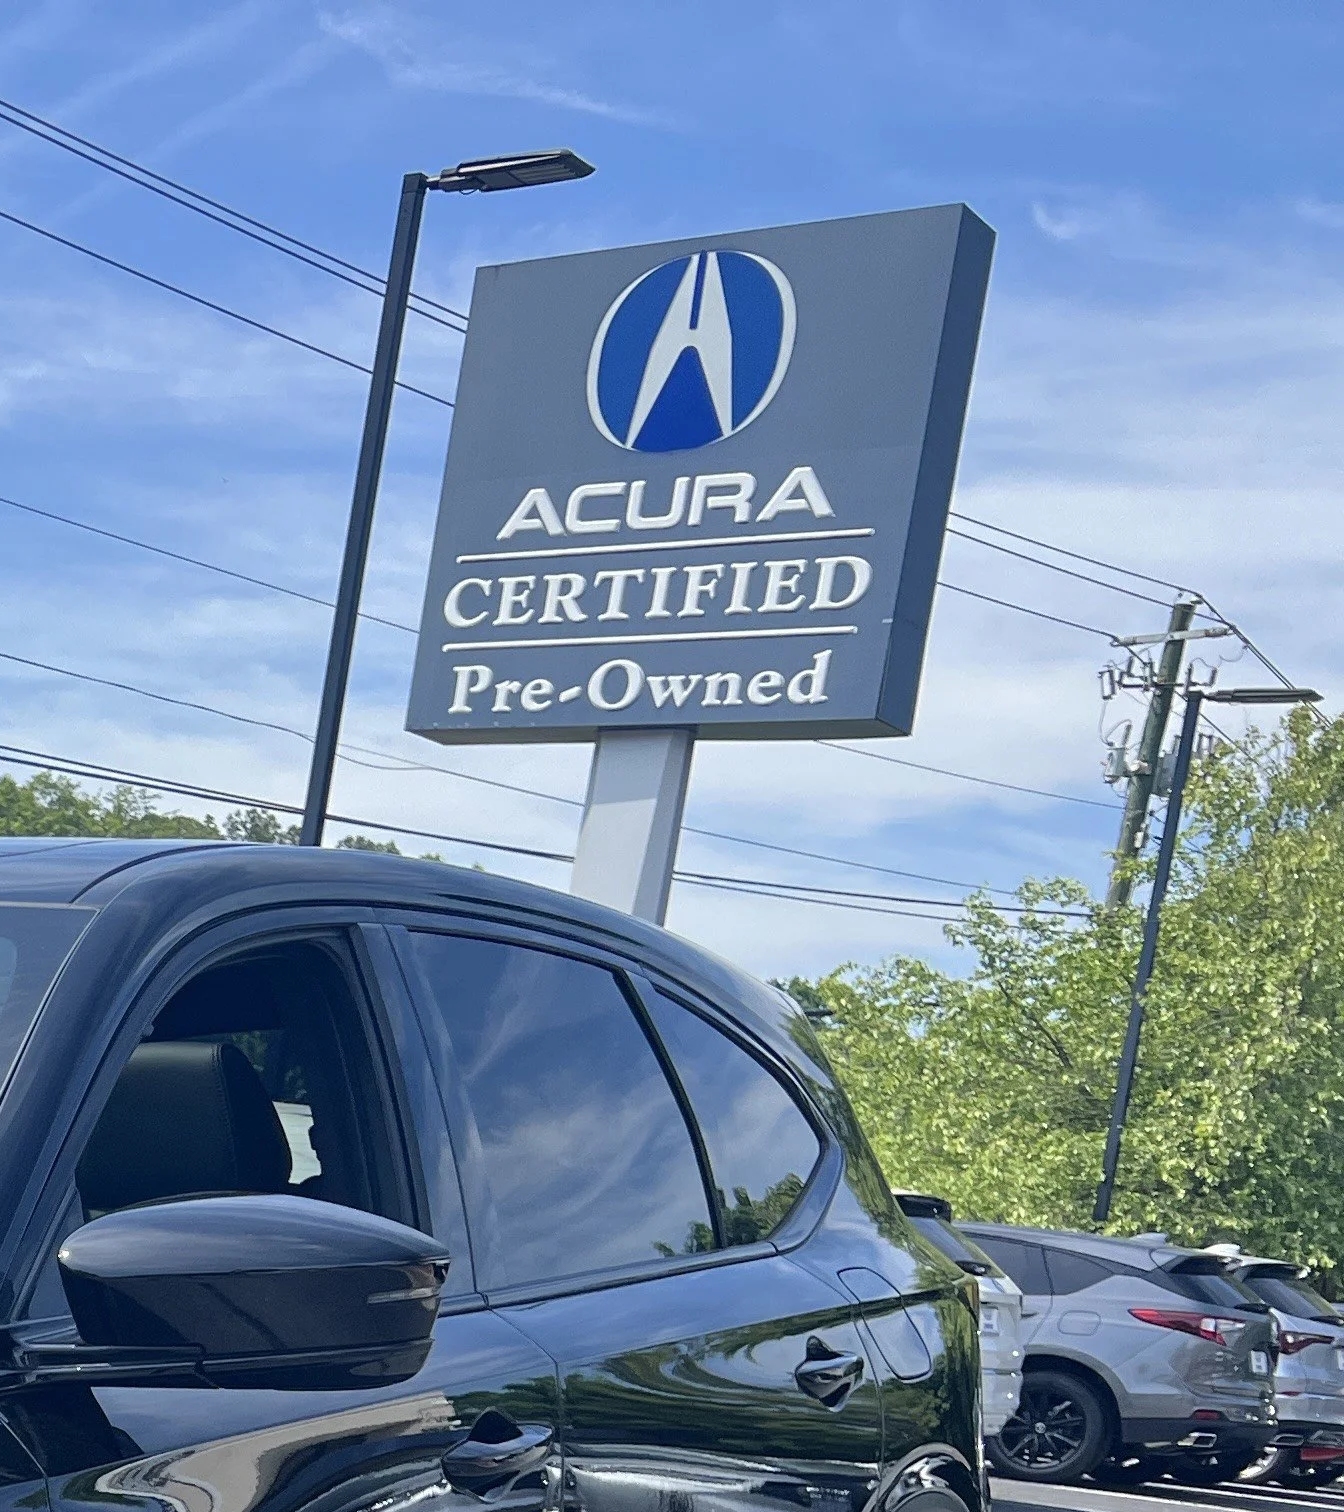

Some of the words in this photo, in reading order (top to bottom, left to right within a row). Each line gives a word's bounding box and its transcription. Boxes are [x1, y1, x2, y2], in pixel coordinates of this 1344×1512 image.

[496, 465, 836, 541] ACURA
[442, 554, 874, 629] CERTIFIED
[447, 649, 833, 714] Pre-Owned
